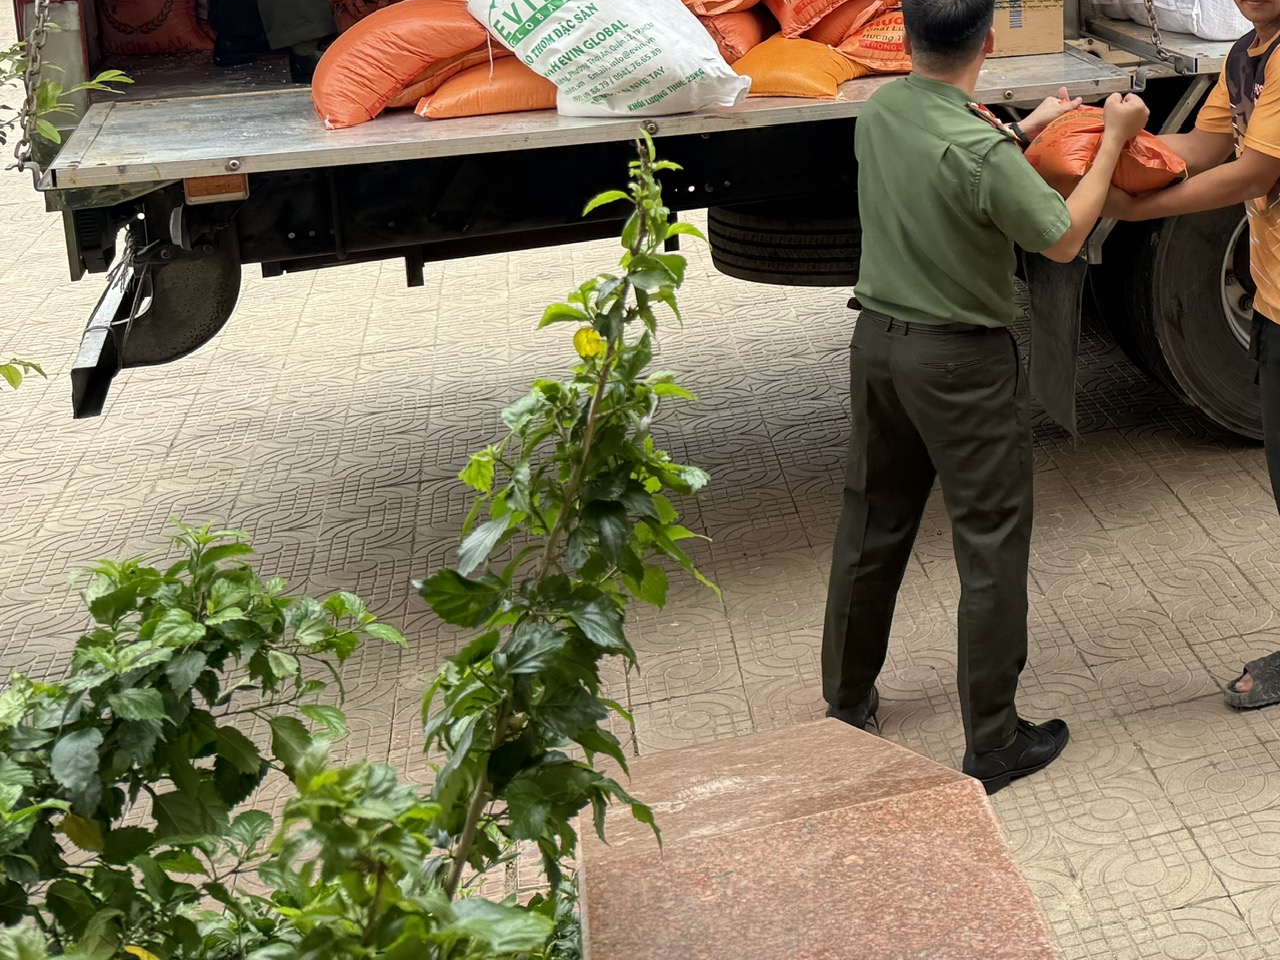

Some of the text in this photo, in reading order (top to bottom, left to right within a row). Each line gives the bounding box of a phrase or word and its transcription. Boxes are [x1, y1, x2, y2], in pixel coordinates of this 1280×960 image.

[558, 45, 585, 67] EVIN
[583, 19, 629, 50] GLOBAL
[587, 64, 611, 81] Email:
[610, 36, 656, 68] info@evin.vn
[612, 47, 663, 81] 0941.76.65.89
[627, 98, 646, 112] KHỐI
[685, 67, 705, 83] 25KG
[647, 65, 665, 80] TAY
